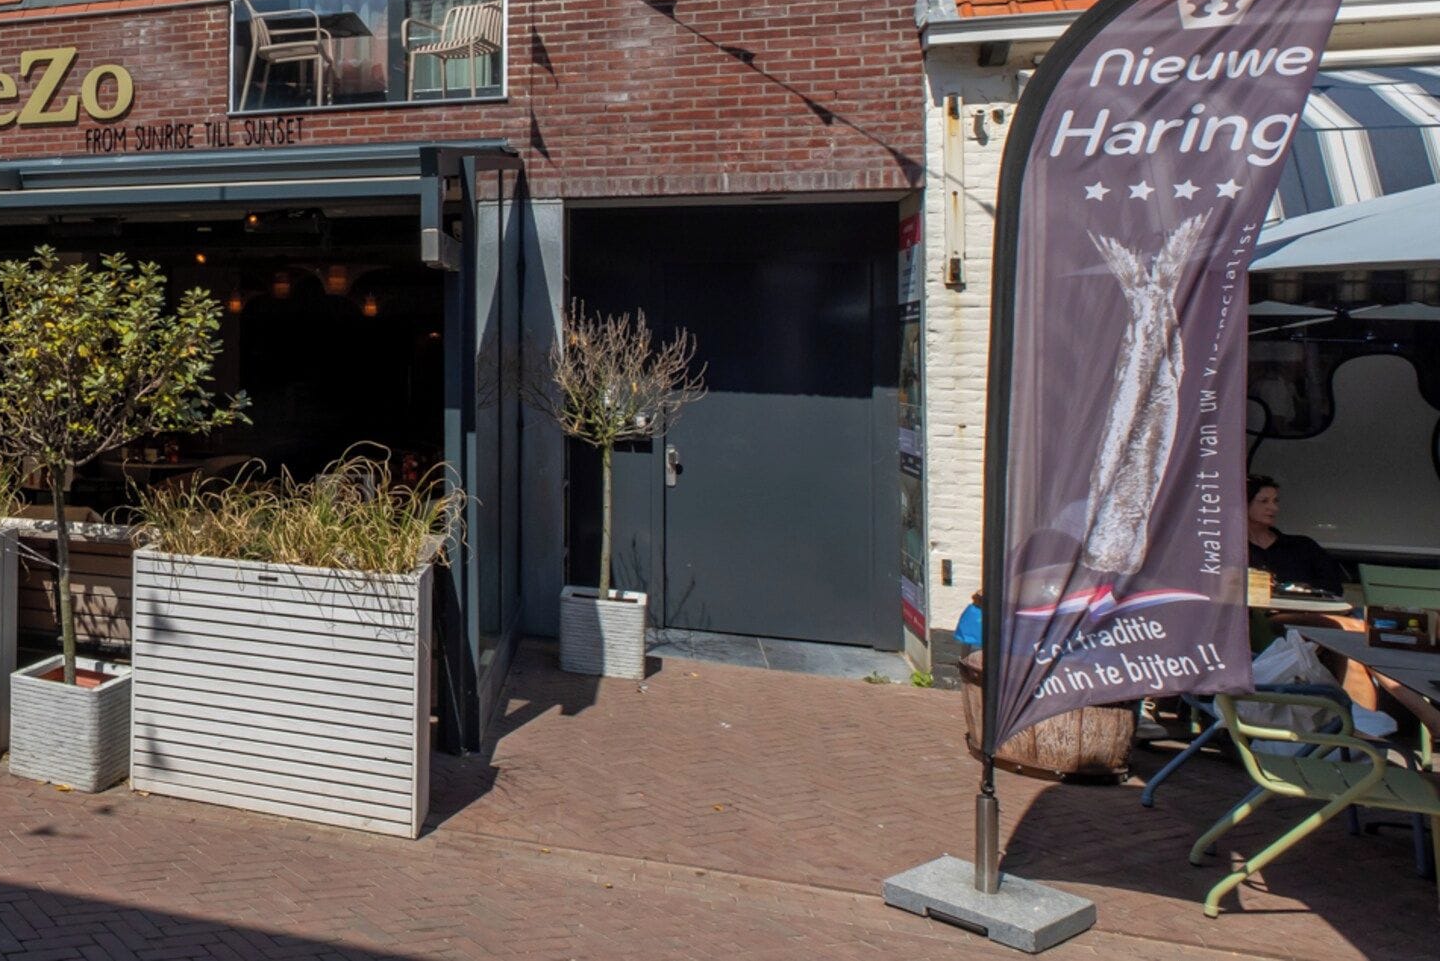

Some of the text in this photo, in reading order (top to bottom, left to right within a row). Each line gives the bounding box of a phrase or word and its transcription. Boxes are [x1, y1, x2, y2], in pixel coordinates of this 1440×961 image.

[85, 116, 305, 153] FROM SUNRISE TILL SUNSET
[1049, 102, 1299, 167] Haring
[1199, 390, 1218, 413] uw
[1199, 424, 1219, 458] van
[1195, 471, 1222, 576] kwaliteit
[1064, 667, 1094, 691] in
[1095, 662, 1124, 686] te
[1119, 652, 1199, 690] bijten
